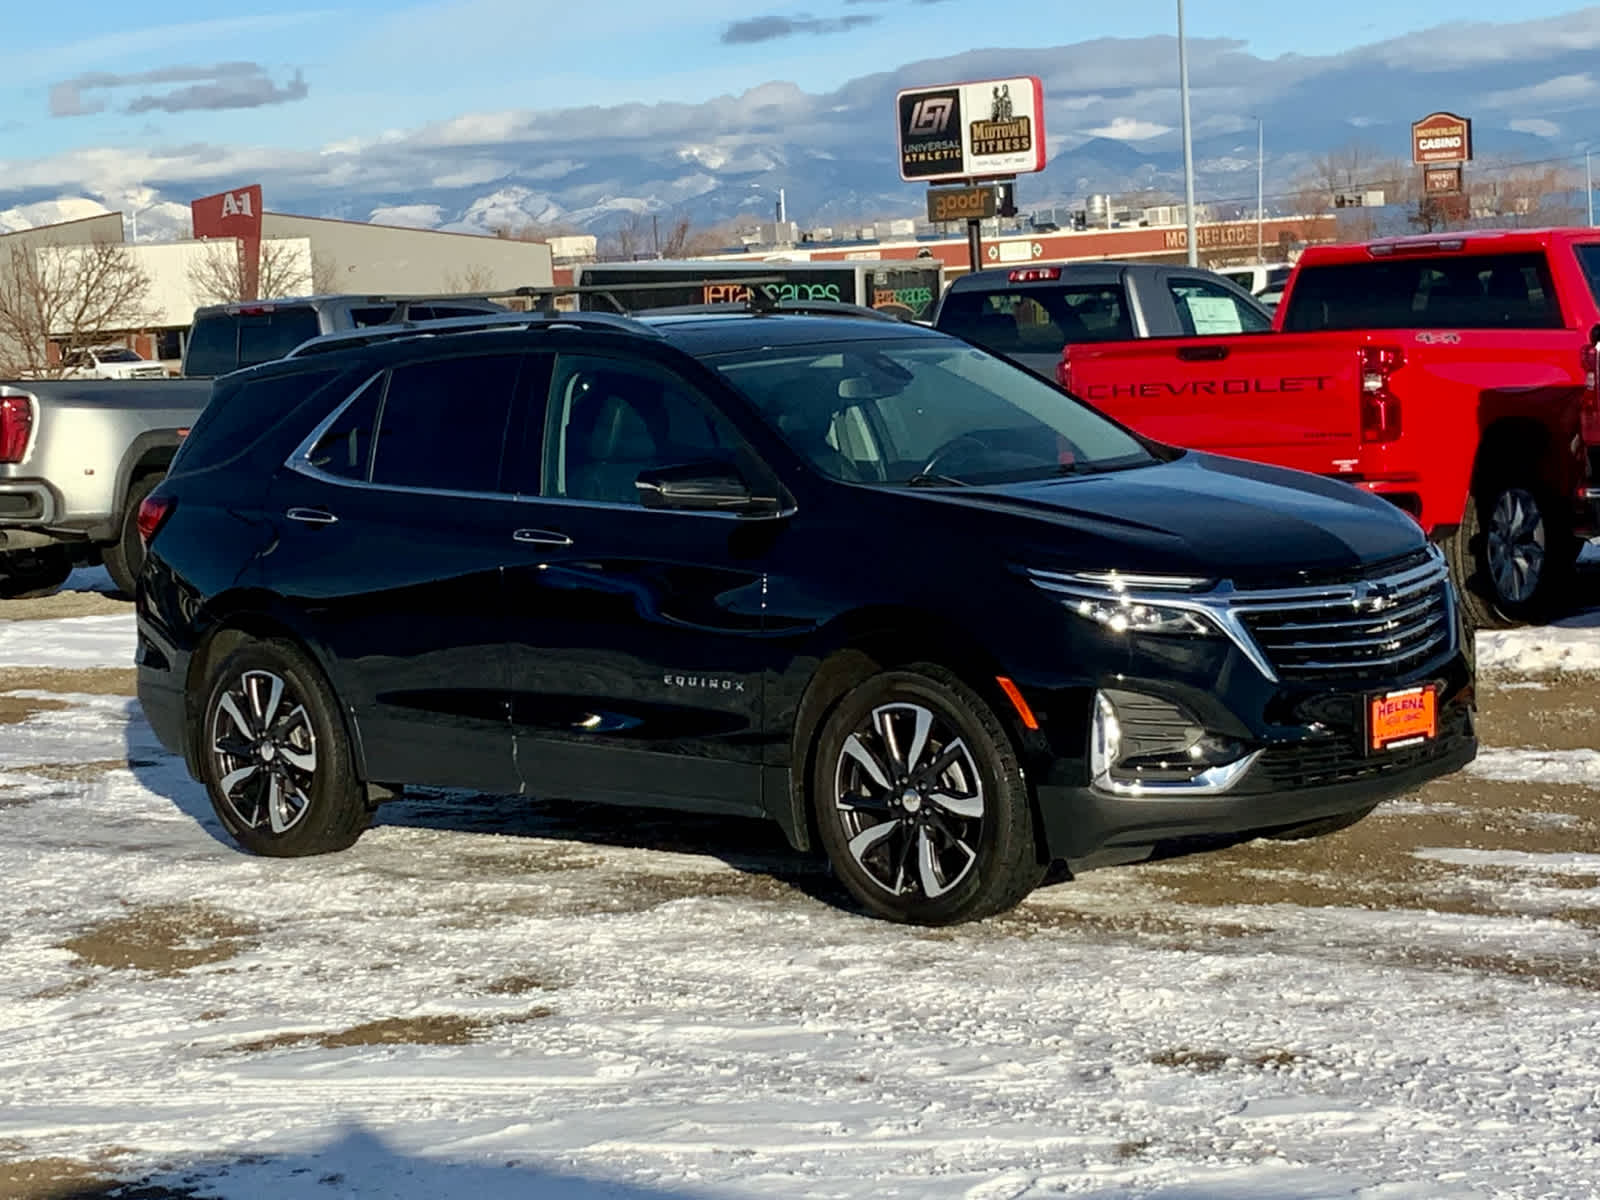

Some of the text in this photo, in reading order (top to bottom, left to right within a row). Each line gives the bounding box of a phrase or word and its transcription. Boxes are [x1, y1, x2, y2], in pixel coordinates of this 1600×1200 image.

[972, 118, 1028, 141] MIDTOWN
[903, 139, 961, 153] UNIVERSAL
[972, 137, 1029, 154] FITNESS
[1419, 136, 1461, 150] CASINO
[904, 149, 961, 164] ATHLETIC
[221, 192, 254, 218] A-1
[1087, 375, 1333, 400] CHEVROLET
[663, 674, 745, 693] EQUINOX
[1378, 697, 1426, 718] HELENA
